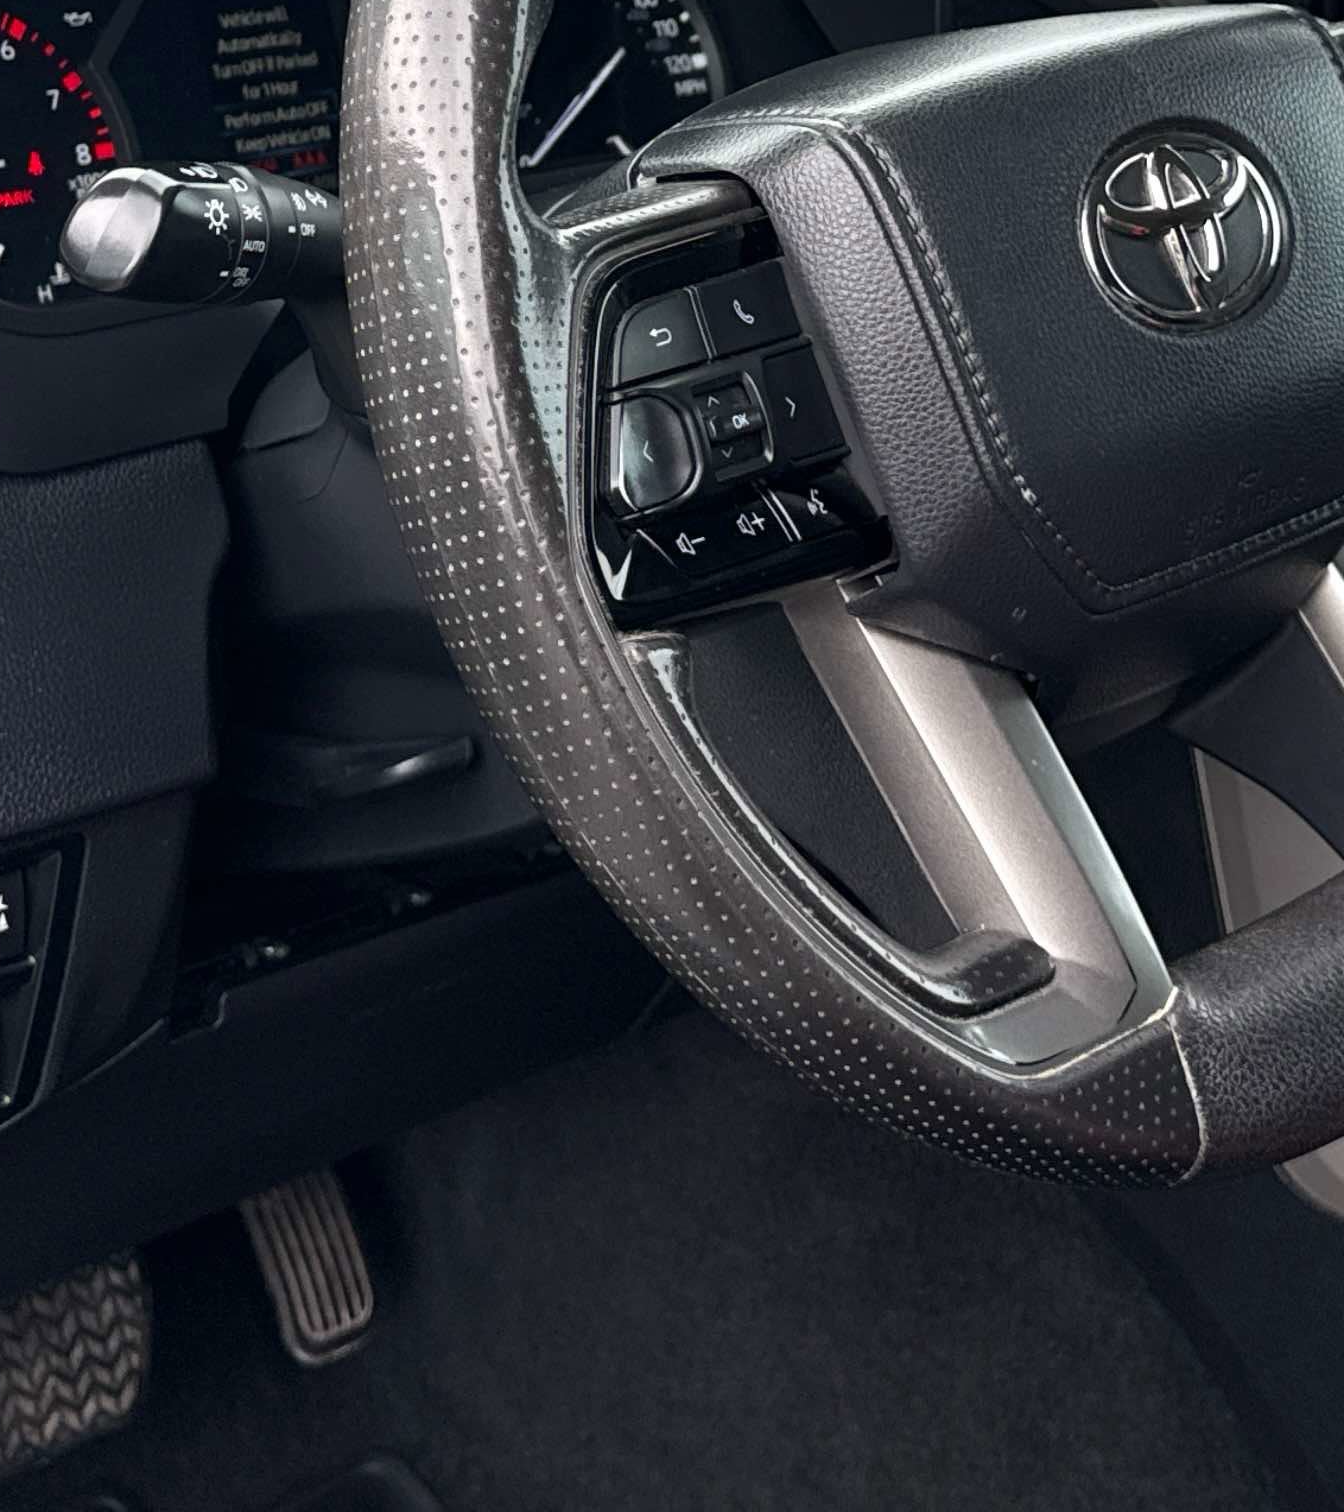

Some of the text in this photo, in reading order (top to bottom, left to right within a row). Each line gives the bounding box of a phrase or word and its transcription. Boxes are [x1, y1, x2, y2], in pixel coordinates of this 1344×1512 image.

[653, 17, 680, 38] 110
[0, 40, 16, 61] 6
[664, 53, 693, 75] 120
[46, 89, 60, 111] 7
[75, 143, 92, 166] 8
[300, 222, 316, 237] OFF
[243, 239, 266, 253] AUTO
[37, 284, 54, 304] H
[731, 411, 750, 430] OK
